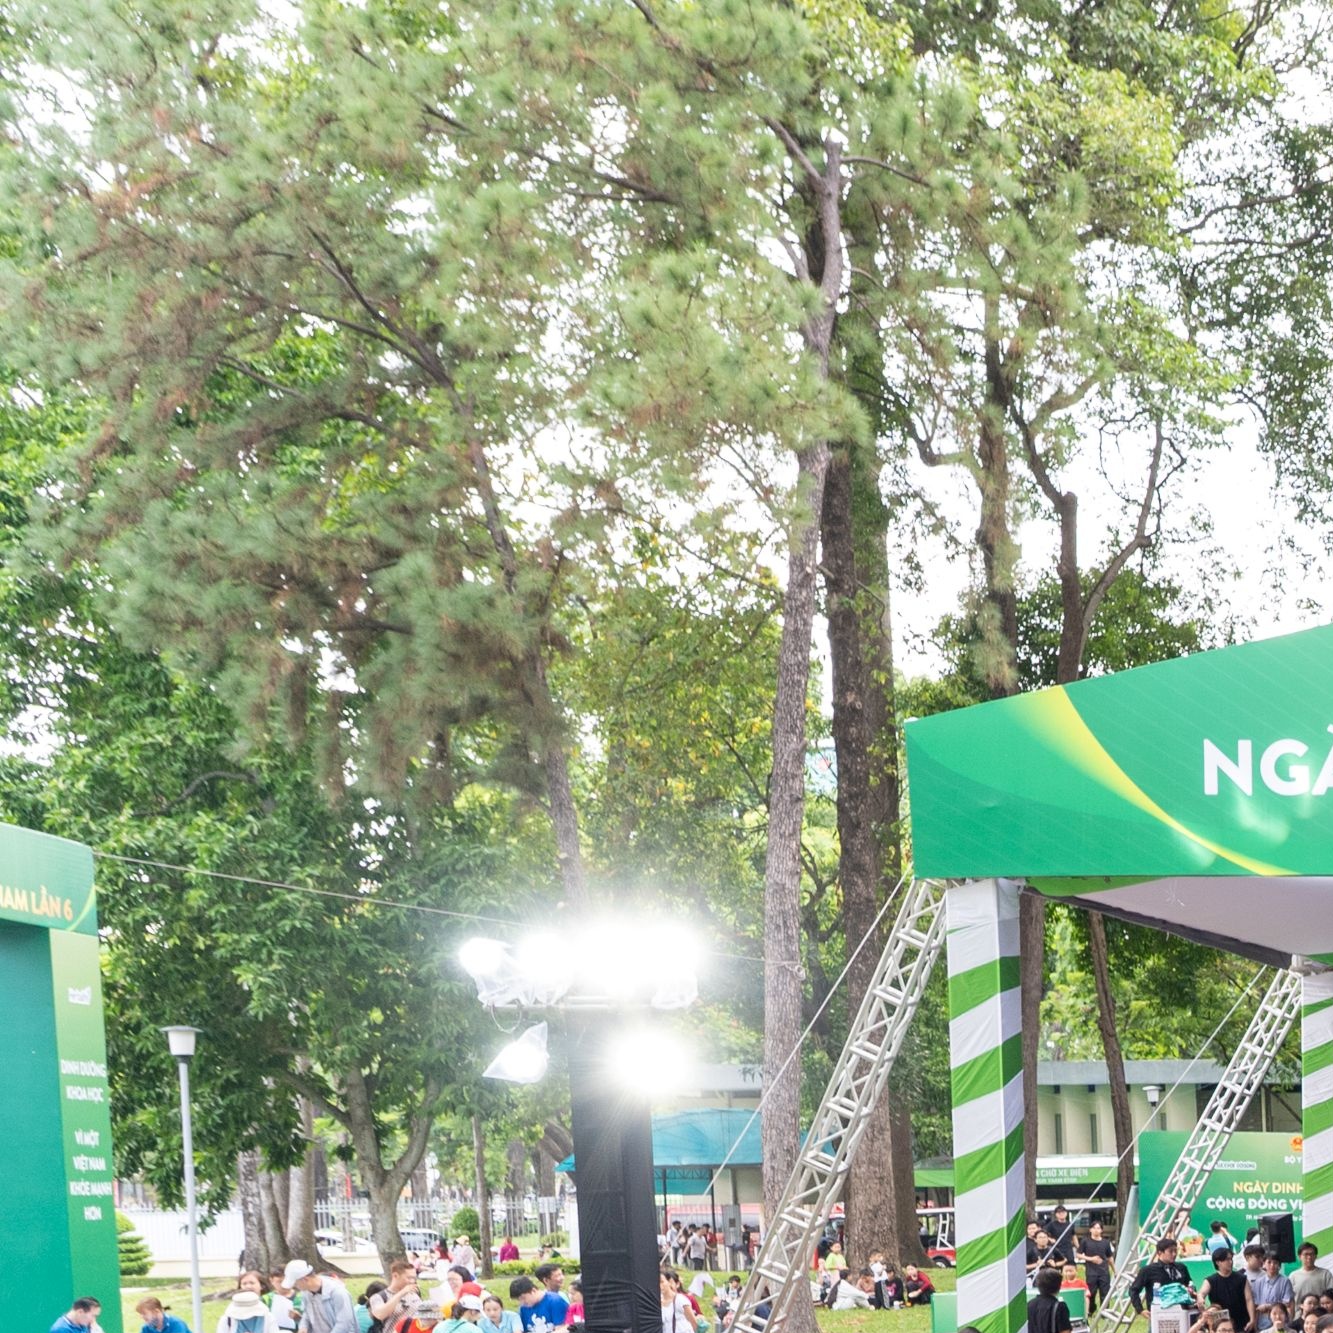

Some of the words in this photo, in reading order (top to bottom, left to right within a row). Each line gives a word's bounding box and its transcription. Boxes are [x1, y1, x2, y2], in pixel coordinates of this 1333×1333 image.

[0, 885, 29, 913] AM
[64, 898, 74, 921] 6
[1233, 1180, 1269, 1194] NGÀY
[1206, 1195, 1246, 1212] CỘNG
[1247, 1194, 1288, 1210] ĐỒNG
